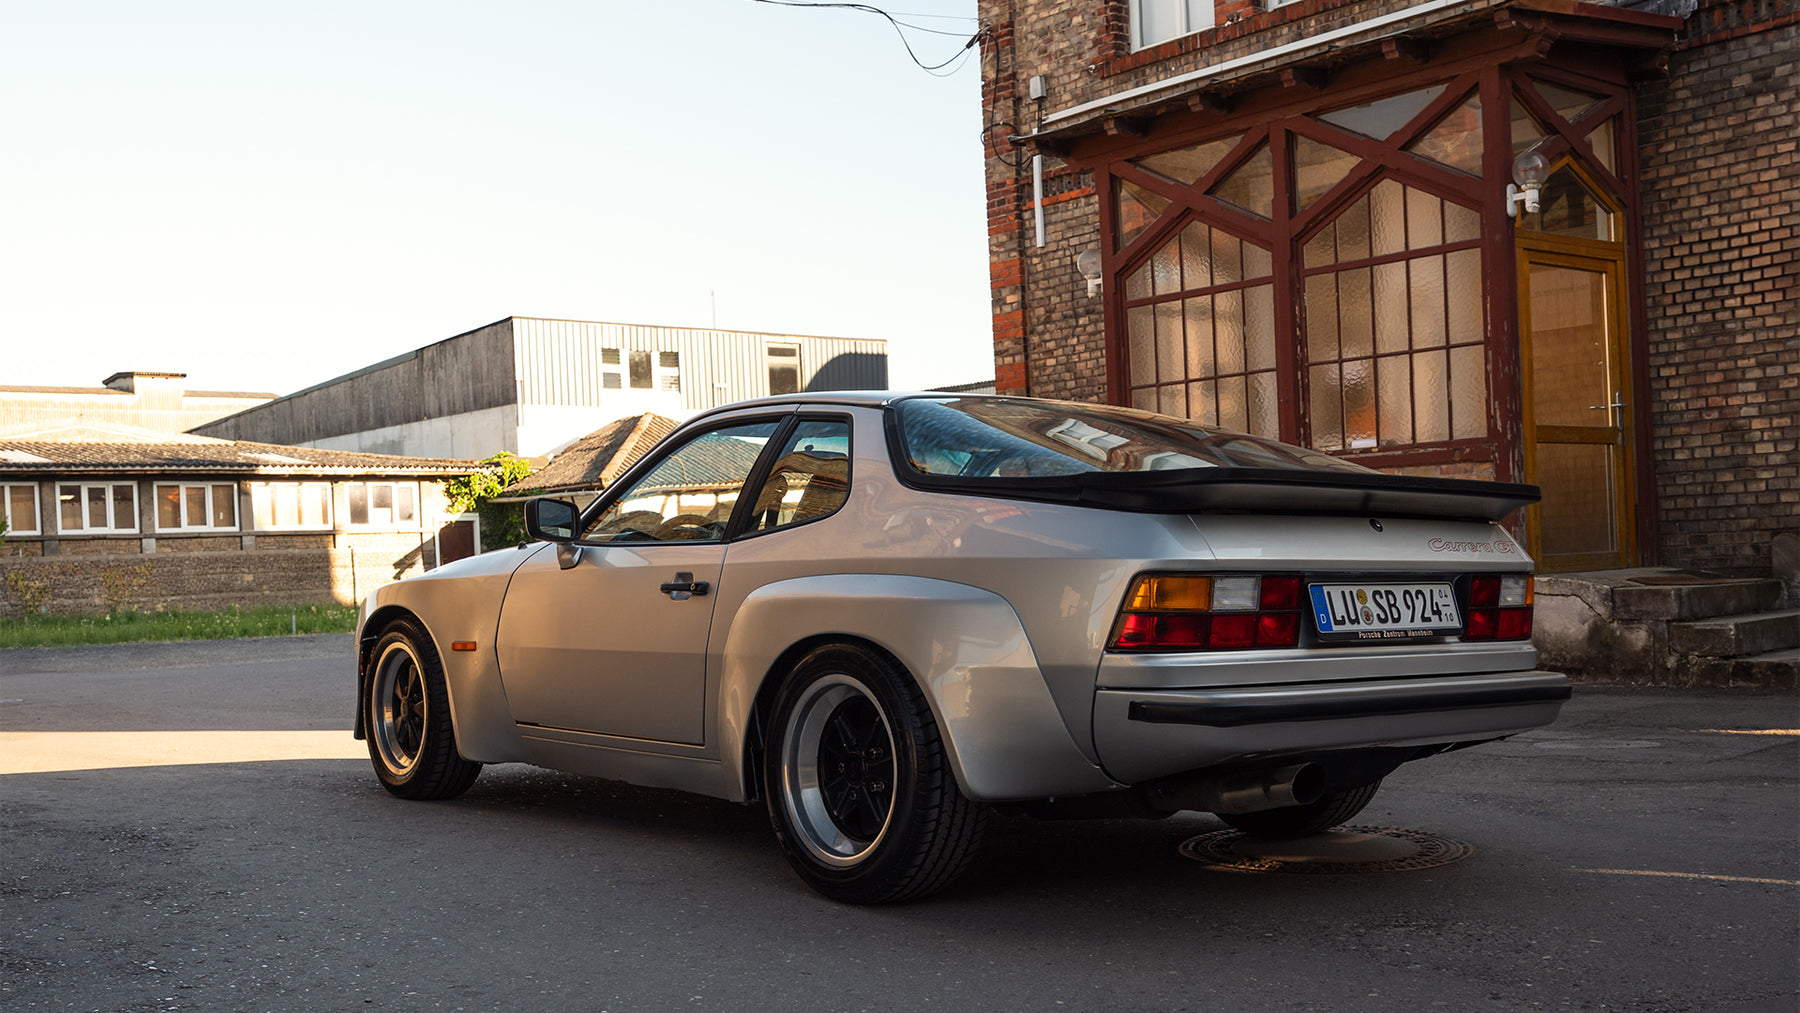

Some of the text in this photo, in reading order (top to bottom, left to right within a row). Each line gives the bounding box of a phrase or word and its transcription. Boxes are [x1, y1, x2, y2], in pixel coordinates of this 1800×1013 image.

[1427, 537, 1493, 553] Carrera
[1326, 588, 1443, 626] LU SB 924
[1319, 613, 1327, 624] D
[1444, 612, 1455, 622] 10
[1358, 631, 1381, 639] Porsche
[1383, 630, 1406, 638] Zentrum
